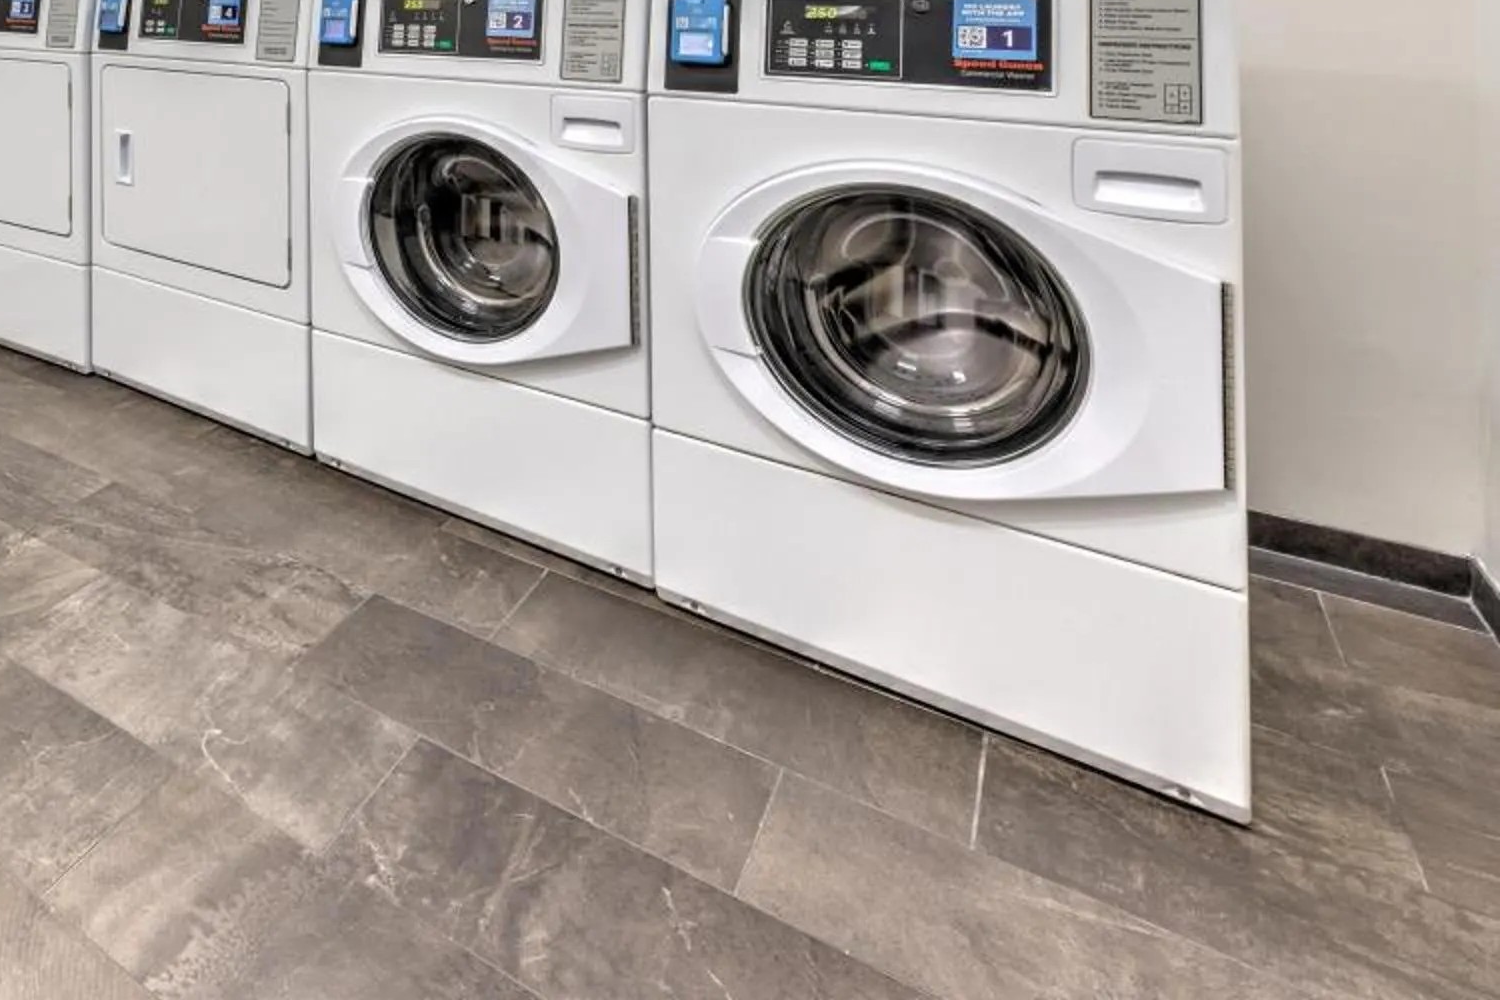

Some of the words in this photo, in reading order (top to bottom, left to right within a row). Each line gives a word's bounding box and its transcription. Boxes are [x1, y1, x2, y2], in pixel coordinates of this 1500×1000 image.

[223, 7, 233, 18] 4
[512, 14, 523, 29] 2
[1002, 29, 1013, 48] 1
